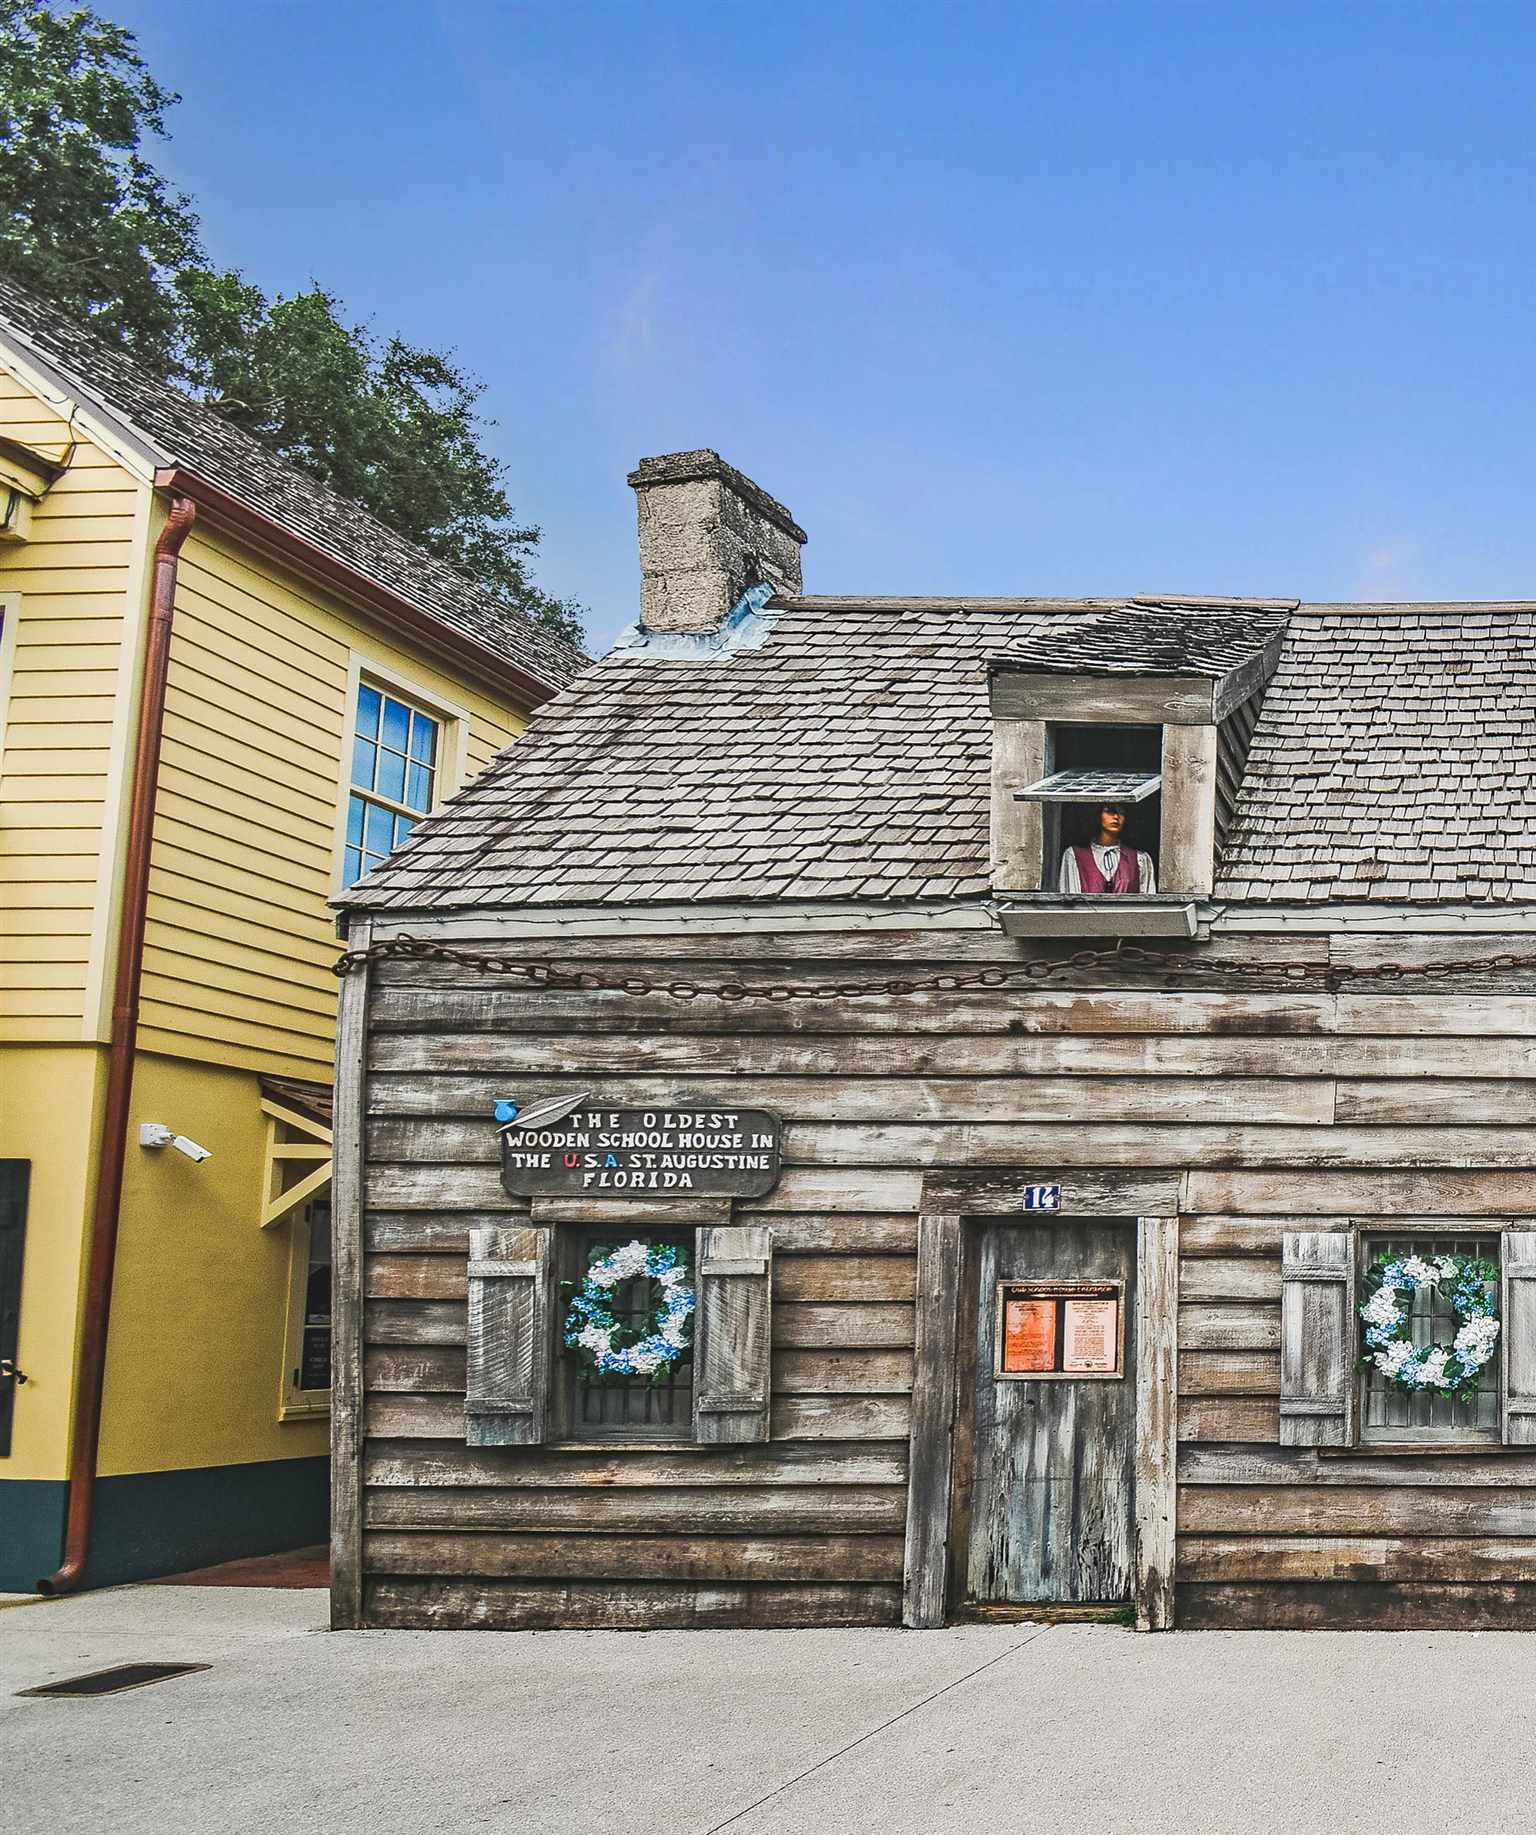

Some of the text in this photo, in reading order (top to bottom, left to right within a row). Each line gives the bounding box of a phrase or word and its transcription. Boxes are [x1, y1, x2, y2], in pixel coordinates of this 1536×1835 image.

[569, 1113, 738, 1129] THE OLDEST
[506, 1132, 773, 1148] WOODEN SCHOOL HOUSE IN
[511, 1153, 551, 1168] THE
[661, 1154, 770, 1170] AUGUSTINE
[583, 1171, 693, 1188] FLORIDA
[1032, 1187, 1054, 1208] 14
